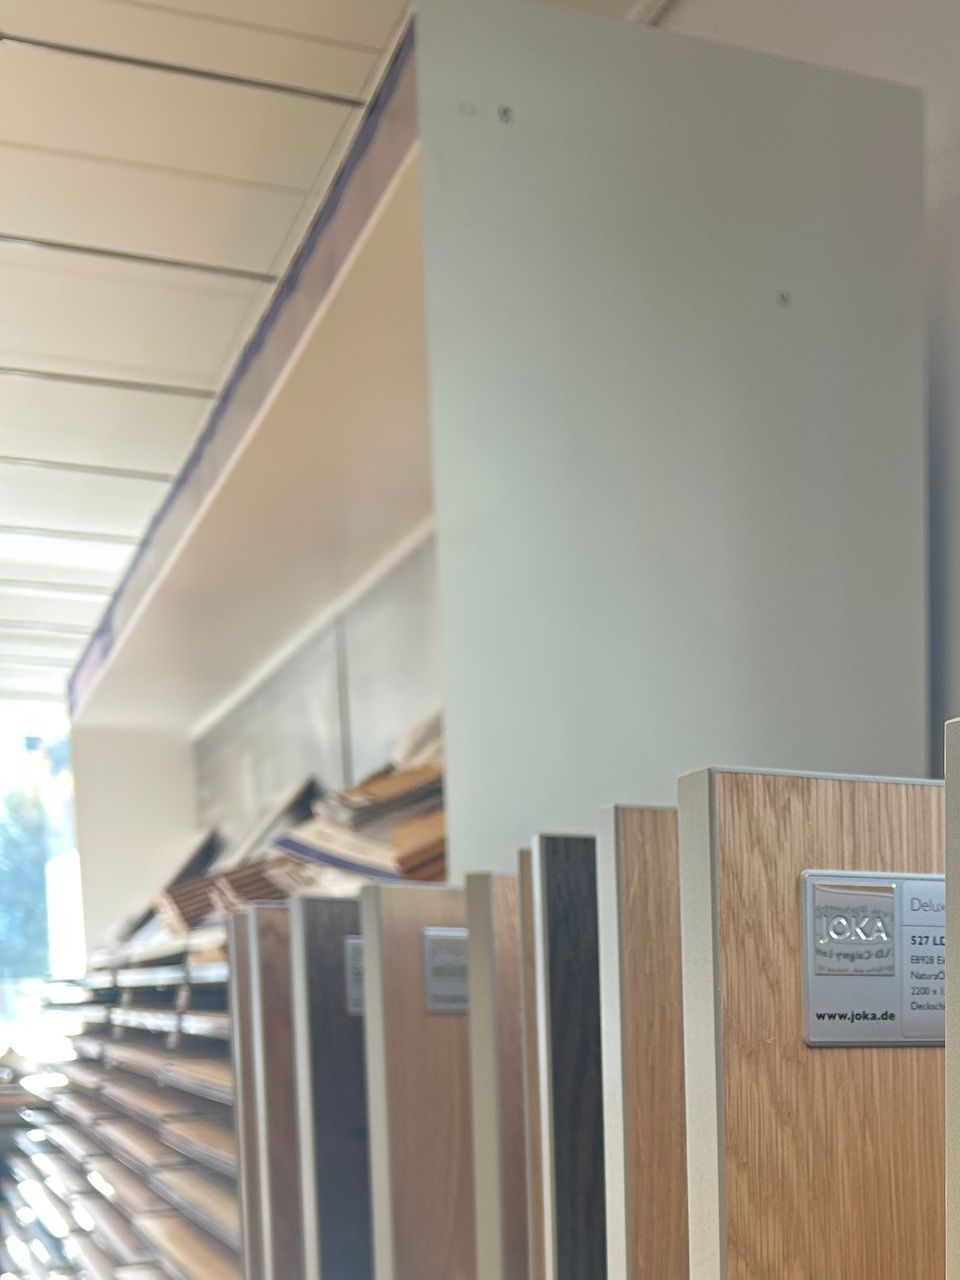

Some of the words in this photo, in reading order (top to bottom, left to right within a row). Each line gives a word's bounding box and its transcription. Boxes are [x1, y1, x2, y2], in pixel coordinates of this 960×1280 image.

[818, 913, 889, 945] JOKA
[911, 935, 930, 946] 527
[815, 1011, 896, 1023] www.joka.de
